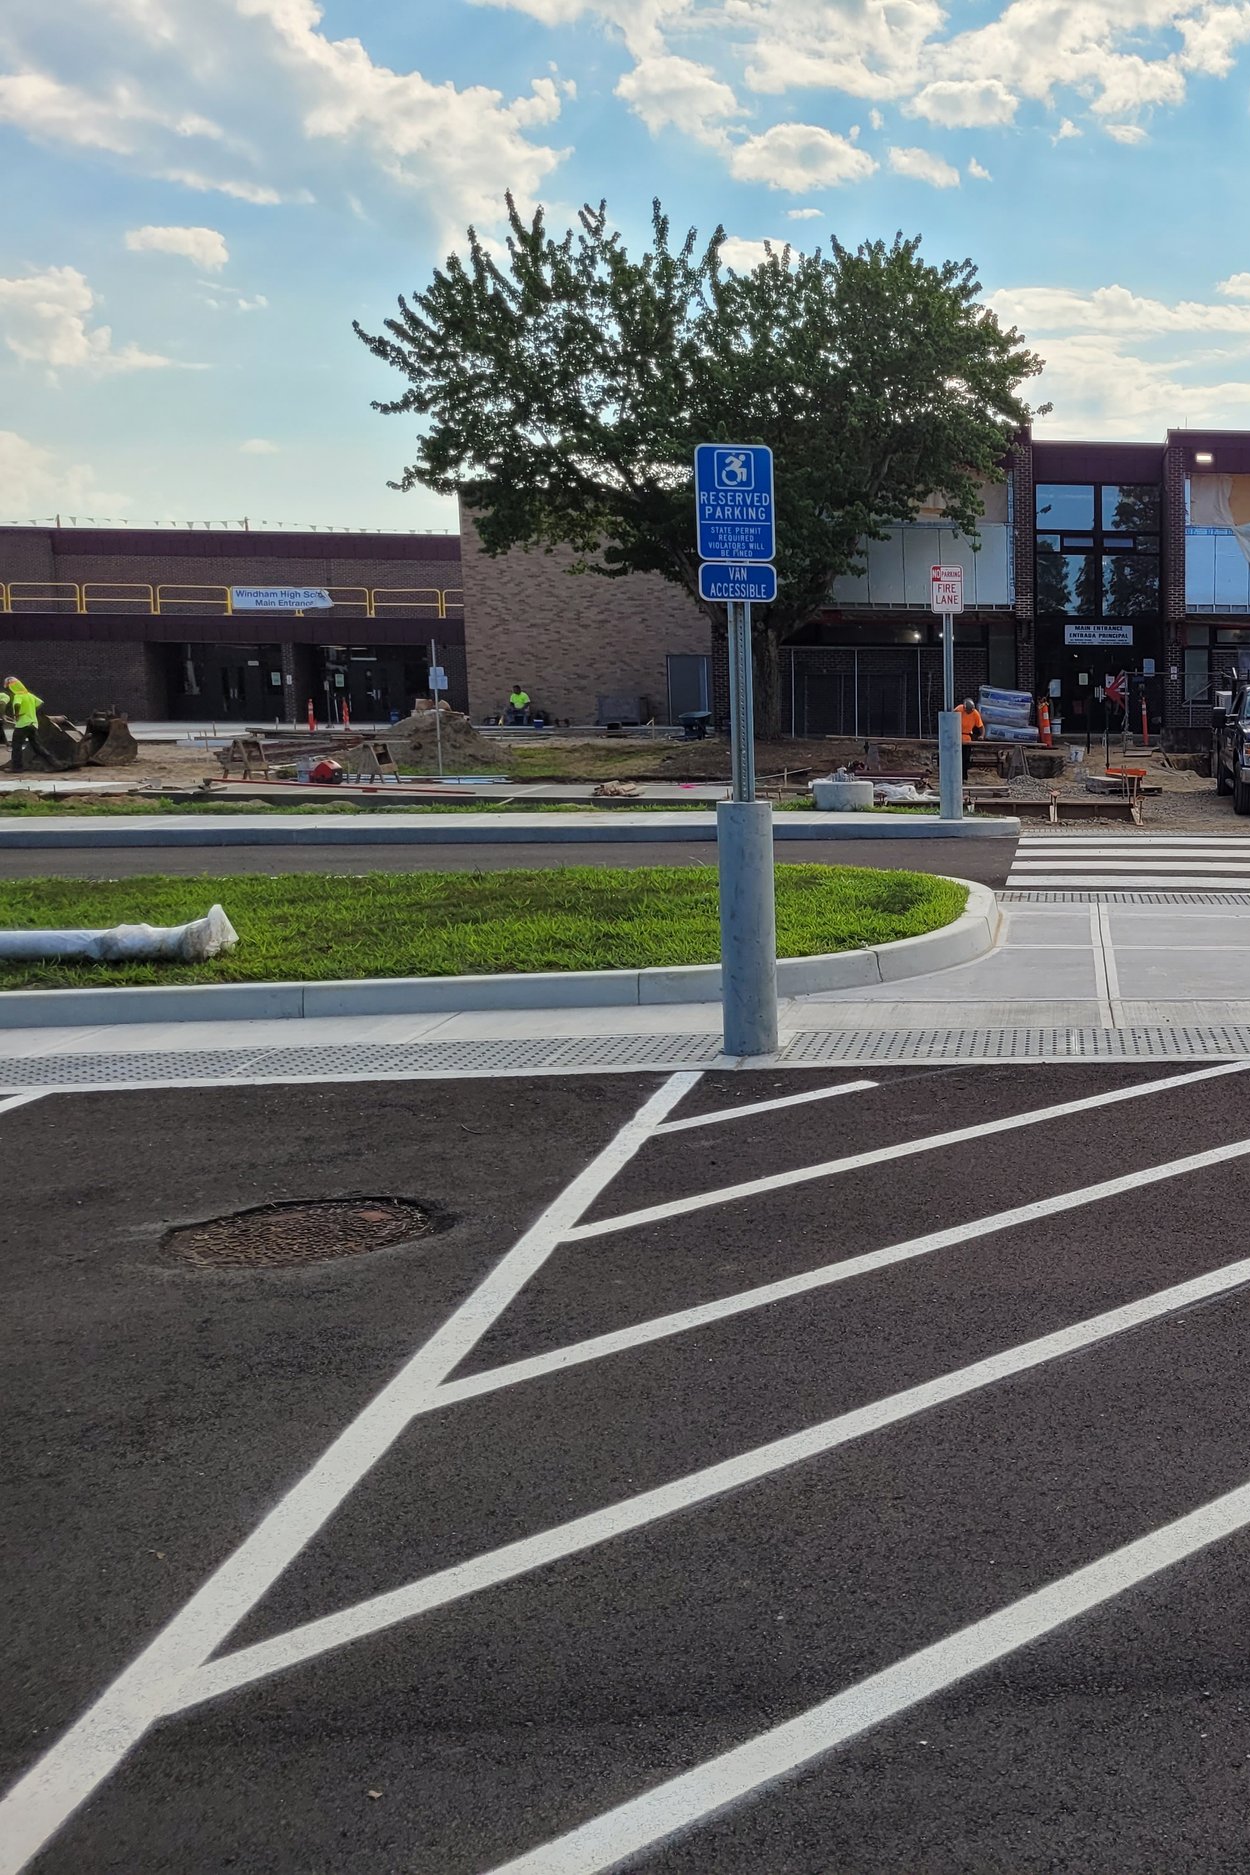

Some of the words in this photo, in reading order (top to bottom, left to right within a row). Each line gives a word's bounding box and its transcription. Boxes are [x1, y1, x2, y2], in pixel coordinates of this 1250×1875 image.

[700, 492, 770, 506] RESERVED
[705, 506, 766, 520] PARKING
[735, 527, 761, 535] PERMIT
[708, 542, 746, 550] VIOLATORS
[728, 567, 748, 581] VAN
[932, 569, 941, 579] NO
[710, 583, 767, 598] ACCESSIBLE
[937, 583, 957, 593] FIRE
[235, 590, 278, 598] Windham
[280, 590, 300, 599] High
[936, 595, 959, 604] LANE
